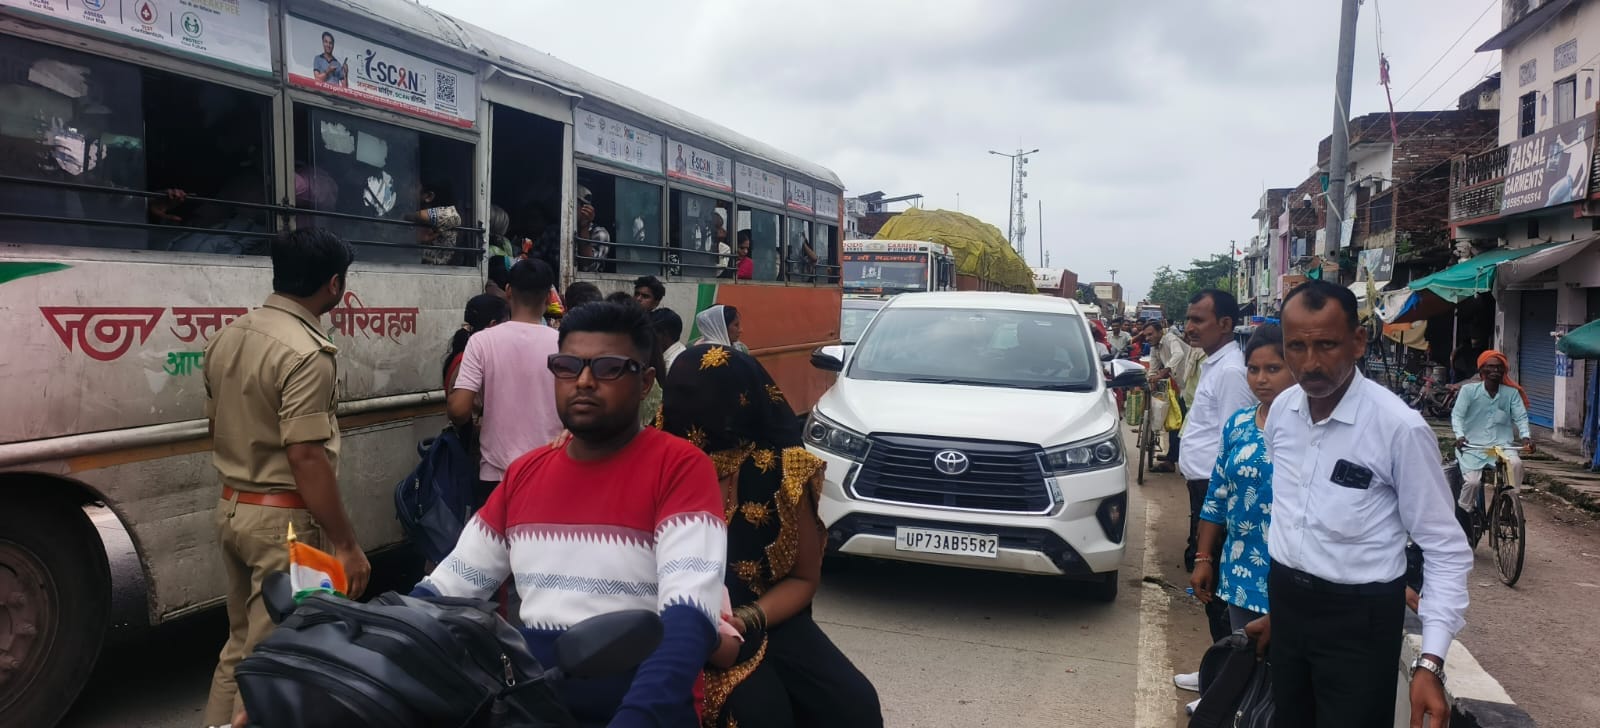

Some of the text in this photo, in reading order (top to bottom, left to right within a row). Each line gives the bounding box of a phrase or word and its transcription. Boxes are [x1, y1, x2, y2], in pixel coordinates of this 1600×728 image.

[182, 36, 204, 45] PROTECT
[1508, 136, 1546, 175] FAISAL
[1504, 167, 1544, 196] GARMENTS
[329, 291, 420, 346] परिवहन
[906, 532, 996, 554] UP73AB5582
